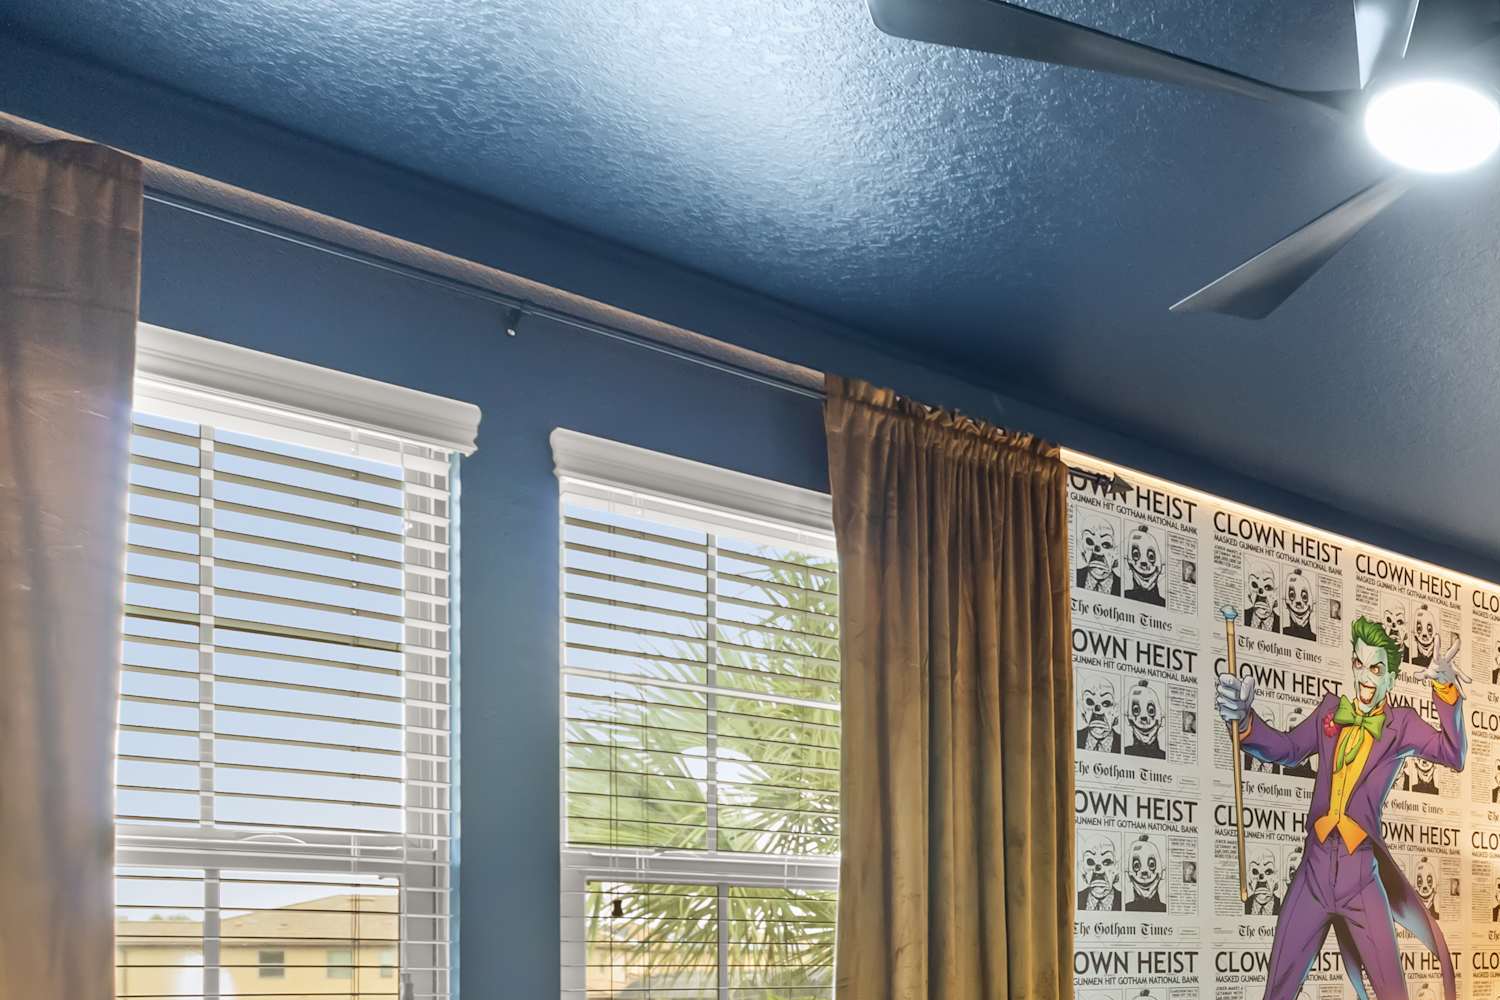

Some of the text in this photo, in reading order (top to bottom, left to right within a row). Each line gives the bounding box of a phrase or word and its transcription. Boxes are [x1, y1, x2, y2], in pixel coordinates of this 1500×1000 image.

[1071, 492, 1198, 535] GUNMEN HIT GOTHAM NATIONAL BANK
[1136, 486, 1197, 523] HEIST
[1214, 511, 1342, 566] CLOWN HEIST
[1214, 534, 1238, 547] MASKED
[1239, 541, 1264, 554] GUNMEN
[1276, 551, 1300, 564] GOTHAM
[1301, 558, 1327, 572] NATIONAL
[1356, 554, 1462, 601] CLOWN HEIST
[1072, 598, 1173, 632] The Gotham Times
[1073, 628, 1198, 673] OWN HEIST
[1238, 635, 1322, 663] The Gotham Times
[1104, 660, 1116, 670] HIT
[1117, 662, 1146, 676] GOTHAM
[1148, 669, 1179, 681] NATIONAL
[1181, 674, 1198, 685] BANK
[1214, 658, 1285, 691] COWN
[1093, 763, 1135, 781] Gotham
[1140, 768, 1173, 784] Times
[1258, 782, 1292, 798] Gotham
[1075, 790, 1198, 823] OWN HEIST
[1214, 805, 1285, 832] CLOWN
[1422, 802, 1444, 814] Times
[1104, 819, 1116, 828] HIT
[1117, 821, 1146, 830] GOTHAM
[1148, 823, 1180, 833] NATIONAL
[1181, 826, 1198, 834] BANK
[1245, 831, 1264, 839] UNMEN
[1381, 822, 1461, 847] OWN HEIST
[1094, 922, 1136, 938] Gotham
[1141, 923, 1174, 936] Times
[1238, 925, 1255, 938] The
[1074, 952, 1198, 975] OWN HEIST
[1215, 952, 1269, 973] CLOW
[1105, 977, 1117, 985] HIT
[1119, 977, 1148, 985] GOTHAM
[1149, 976, 1181, 984] NATIONAL
[1182, 976, 1199, 984] BANK
